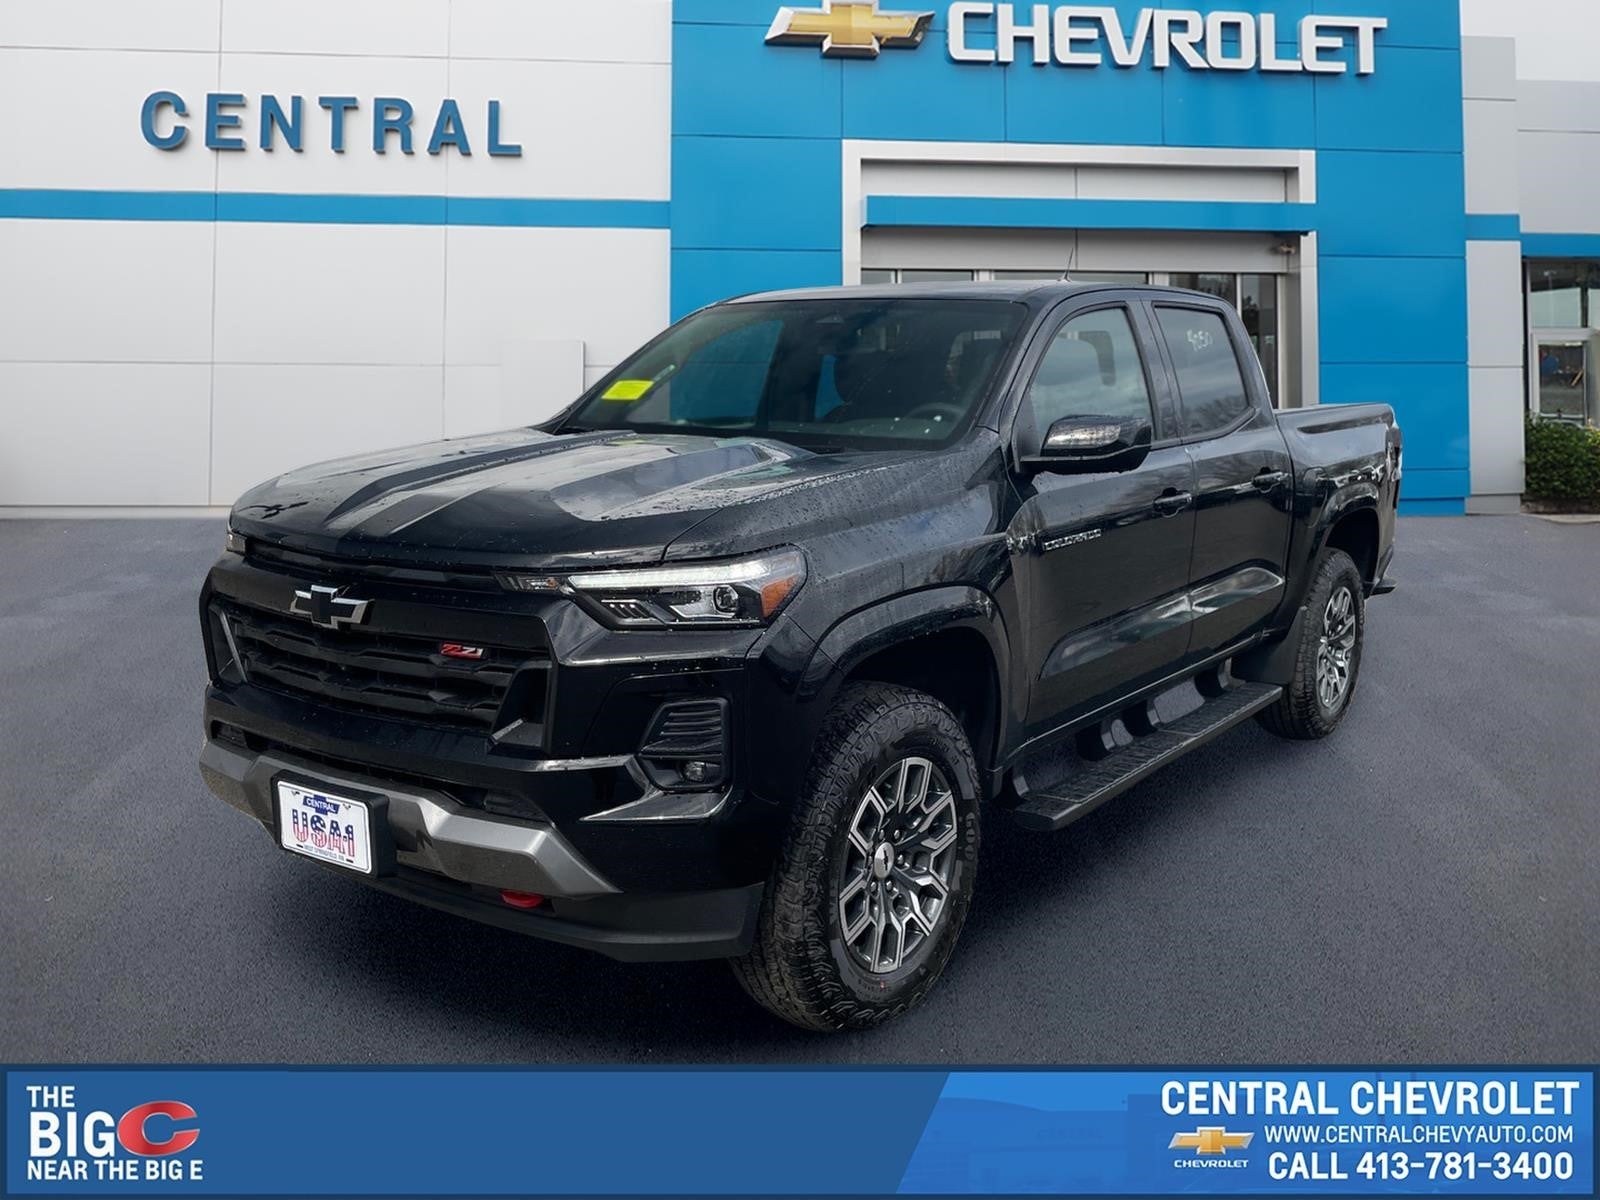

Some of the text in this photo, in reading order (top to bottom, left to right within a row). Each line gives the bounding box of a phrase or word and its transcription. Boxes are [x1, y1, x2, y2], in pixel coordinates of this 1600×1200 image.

[946, 1, 1389, 75] CHEVROLET
[140, 90, 523, 157] CENTRAL
[306, 799, 336, 812] CENTRAL
